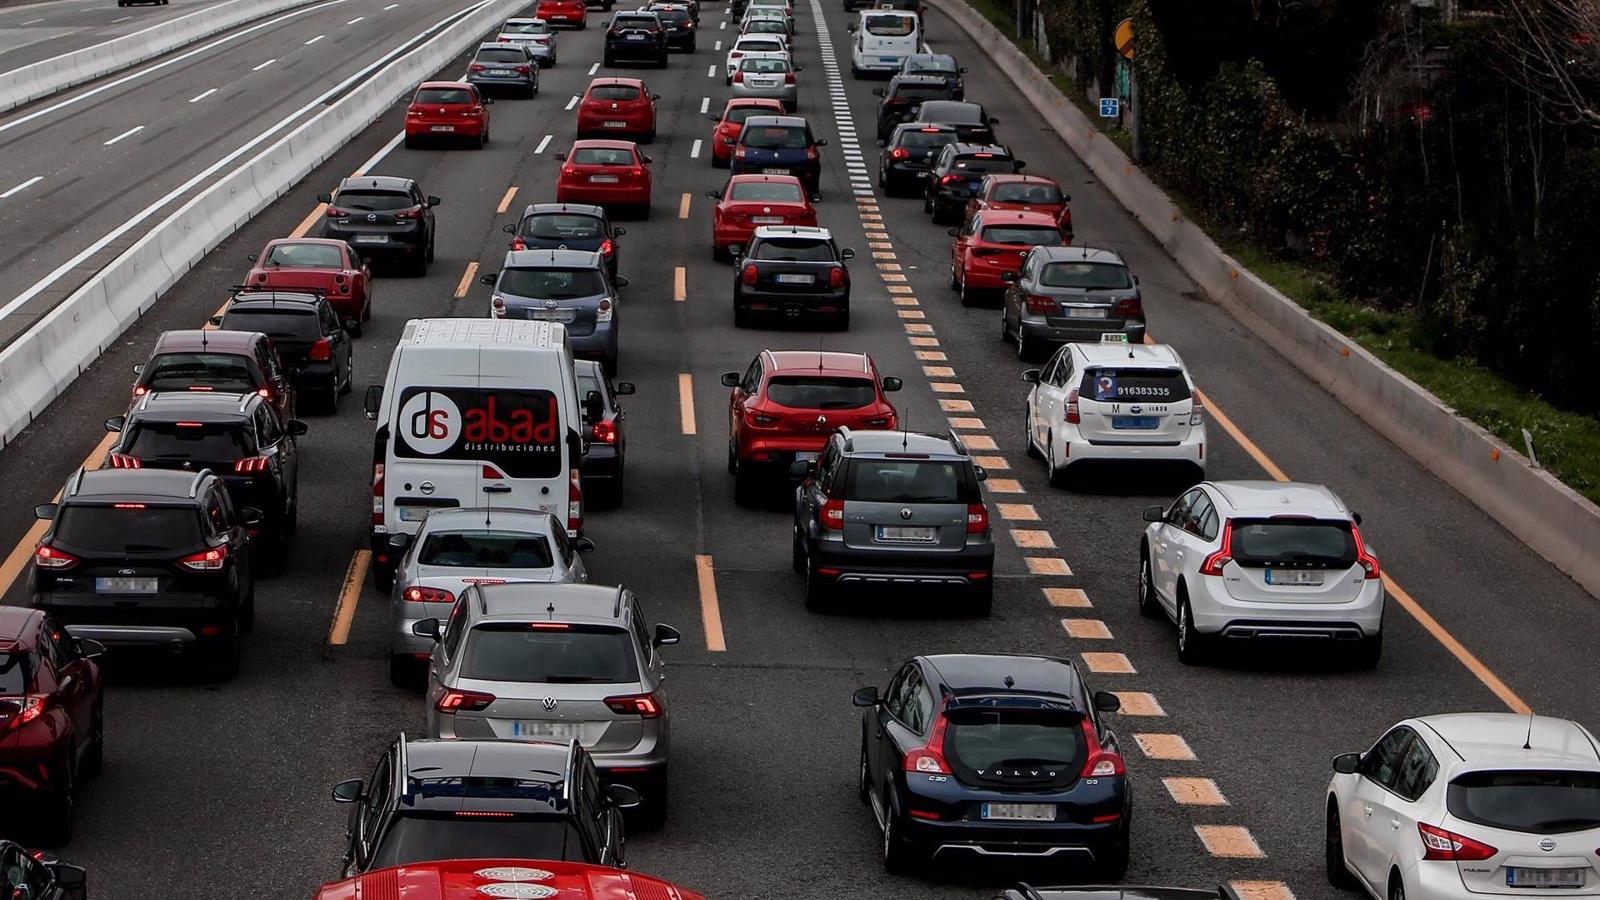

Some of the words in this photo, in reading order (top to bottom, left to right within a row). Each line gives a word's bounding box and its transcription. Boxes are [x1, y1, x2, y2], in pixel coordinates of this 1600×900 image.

[1107, 107, 1112, 115] 7
[1118, 387, 1170, 396] 916383335
[1112, 404, 1120, 414] M
[411, 391, 449, 439] ds
[464, 395, 557, 443] abad
[464, 443, 556, 452] distribuciones
[977, 769, 1056, 777] VOLVO
